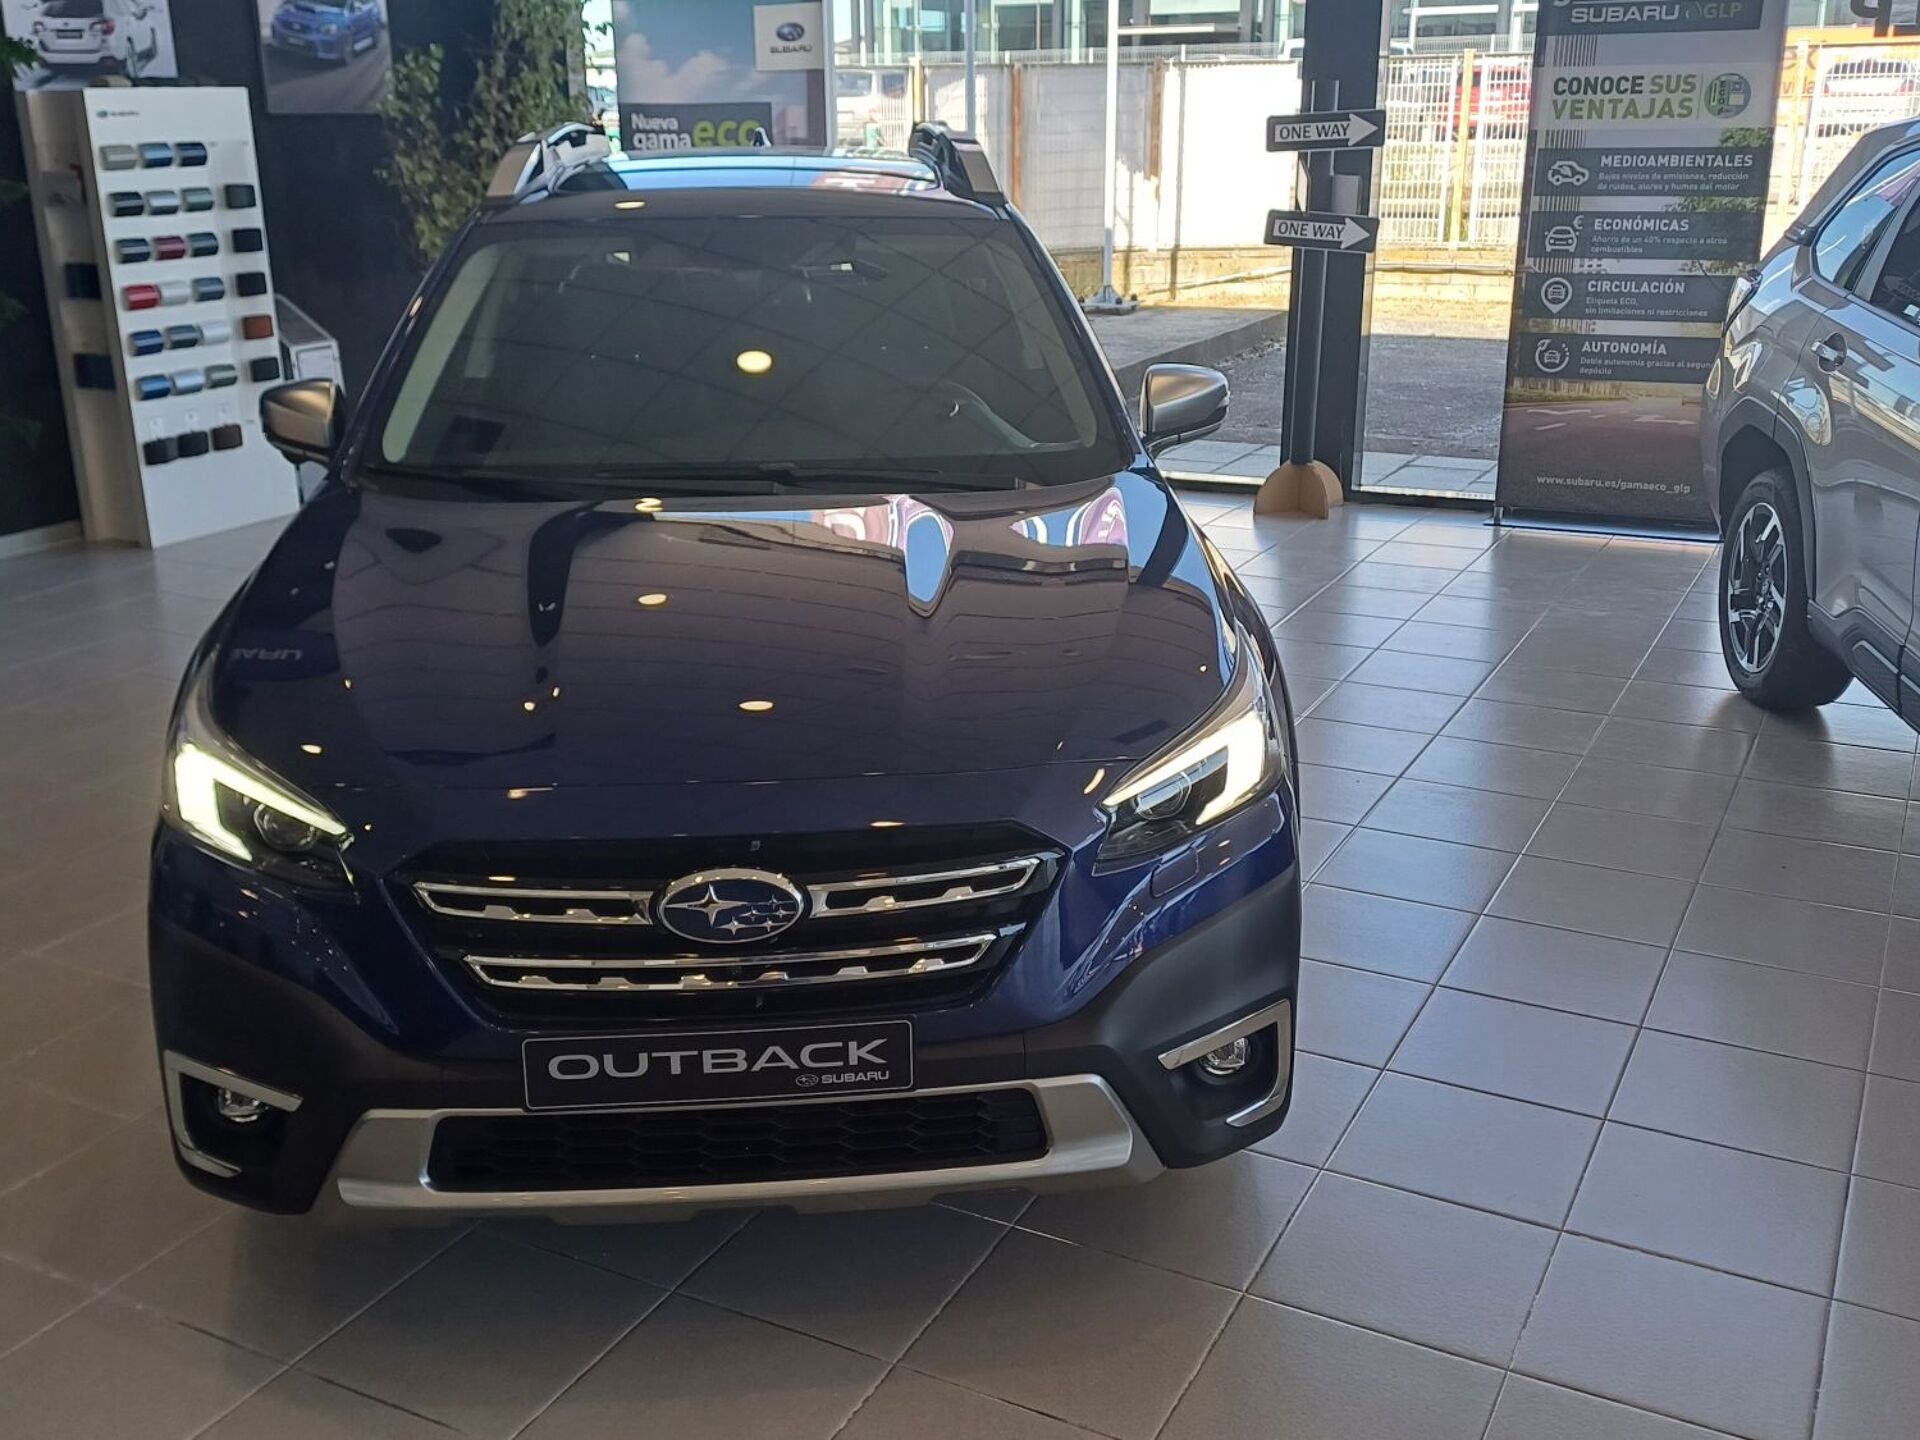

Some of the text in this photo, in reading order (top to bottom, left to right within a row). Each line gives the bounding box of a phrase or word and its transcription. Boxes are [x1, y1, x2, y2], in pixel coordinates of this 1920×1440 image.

[1571, 2, 1743, 23] SUBARU GLP
[1553, 73, 1697, 95] CONOCE SUS
[1552, 97, 1694, 120] VENTAJAS
[631, 113, 679, 131] Nueva
[1279, 122, 1350, 140] ONE WAY
[633, 131, 692, 149] gama
[1600, 154, 1753, 168] MEDIOAMBIENTALES
[1651, 172, 1661, 180] de
[1708, 171, 1749, 180] reducción
[1597, 182, 1607, 190] de
[1278, 221, 1345, 239] ONE WAY
[1594, 215, 1690, 231] ECONÓMICAS
[1591, 235, 1618, 243] Ahorro
[1587, 278, 1686, 293] CIRCULACIÓN
[1586, 297, 1618, 305] Etiqueta
[1599, 307, 1645, 315] limitaciones
[1656, 308, 1708, 317] restricciones
[1582, 339, 1667, 355] AUTONOMÍA
[1580, 366, 1612, 375] depósito
[1581, 356, 1602, 365] Doble
[1647, 360, 1676, 368] gracias
[1676, 360, 1685, 368] al
[1686, 361, 1713, 369] segun
[1536, 475, 1691, 494] www.subaru.es/gamaeco_glp
[548, 1038, 888, 1080] OUTBACK
[820, 1070, 889, 1084] SUBARU
